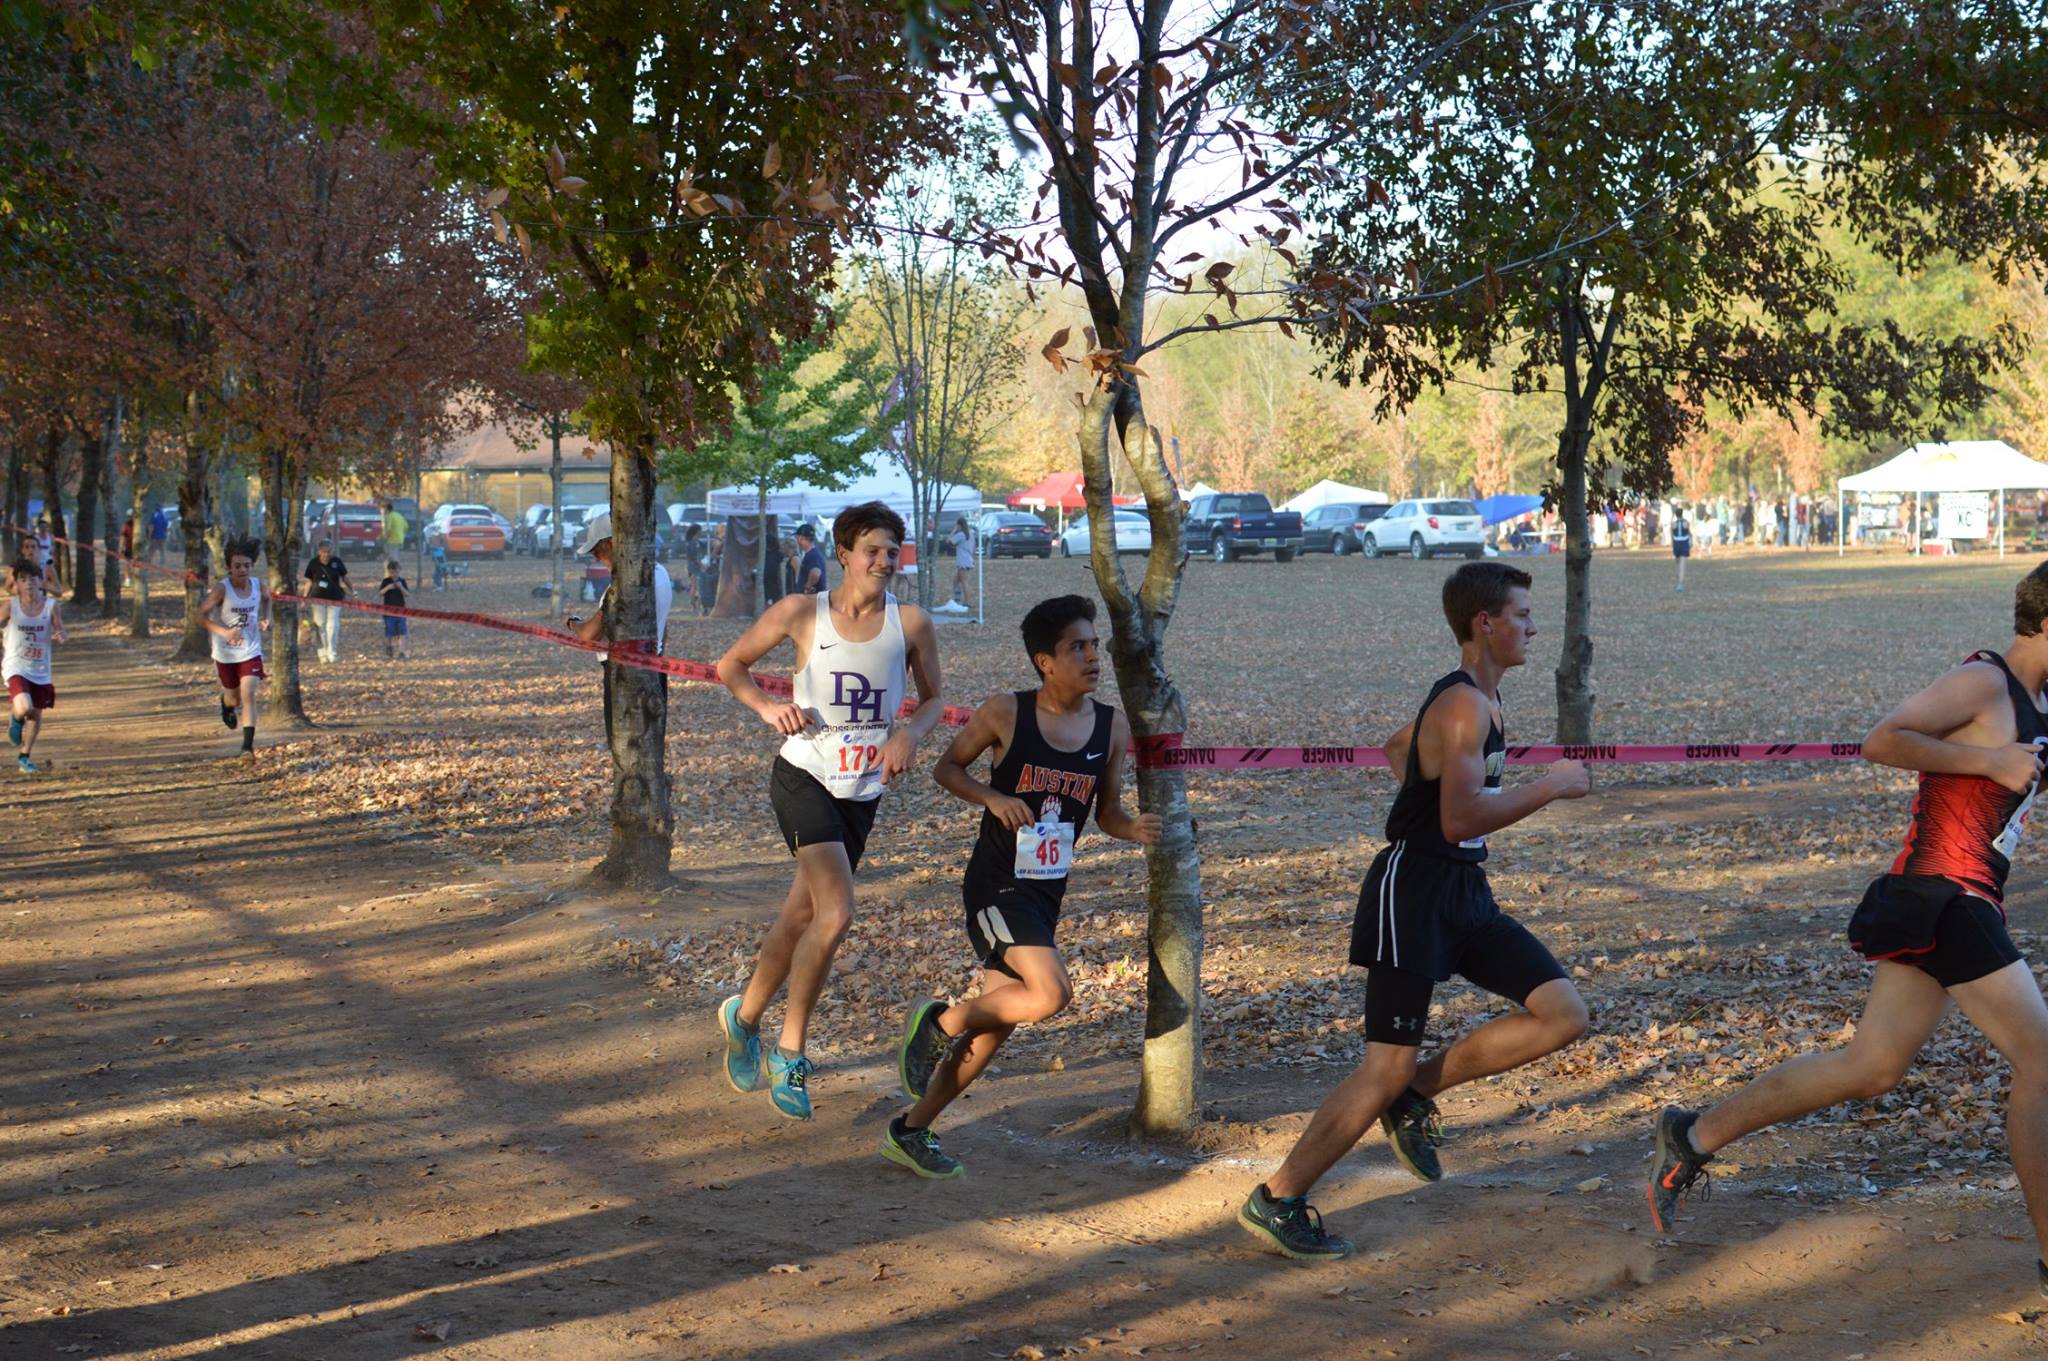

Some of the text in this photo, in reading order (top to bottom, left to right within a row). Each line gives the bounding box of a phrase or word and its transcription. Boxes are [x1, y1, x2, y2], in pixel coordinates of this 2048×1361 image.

[1957, 511, 1973, 527] XC
[830, 671, 887, 723] DH
[821, 724, 849, 732] CROSS
[838, 744, 877, 773] 179
[1164, 748, 1216, 764] DANGER
[1302, 747, 1354, 763] DANGER
[1563, 745, 1616, 759] DANGER
[1685, 744, 1740, 758] DANGER
[1016, 763, 1097, 805] AUSTIN
[1036, 838, 1060, 866] 46
